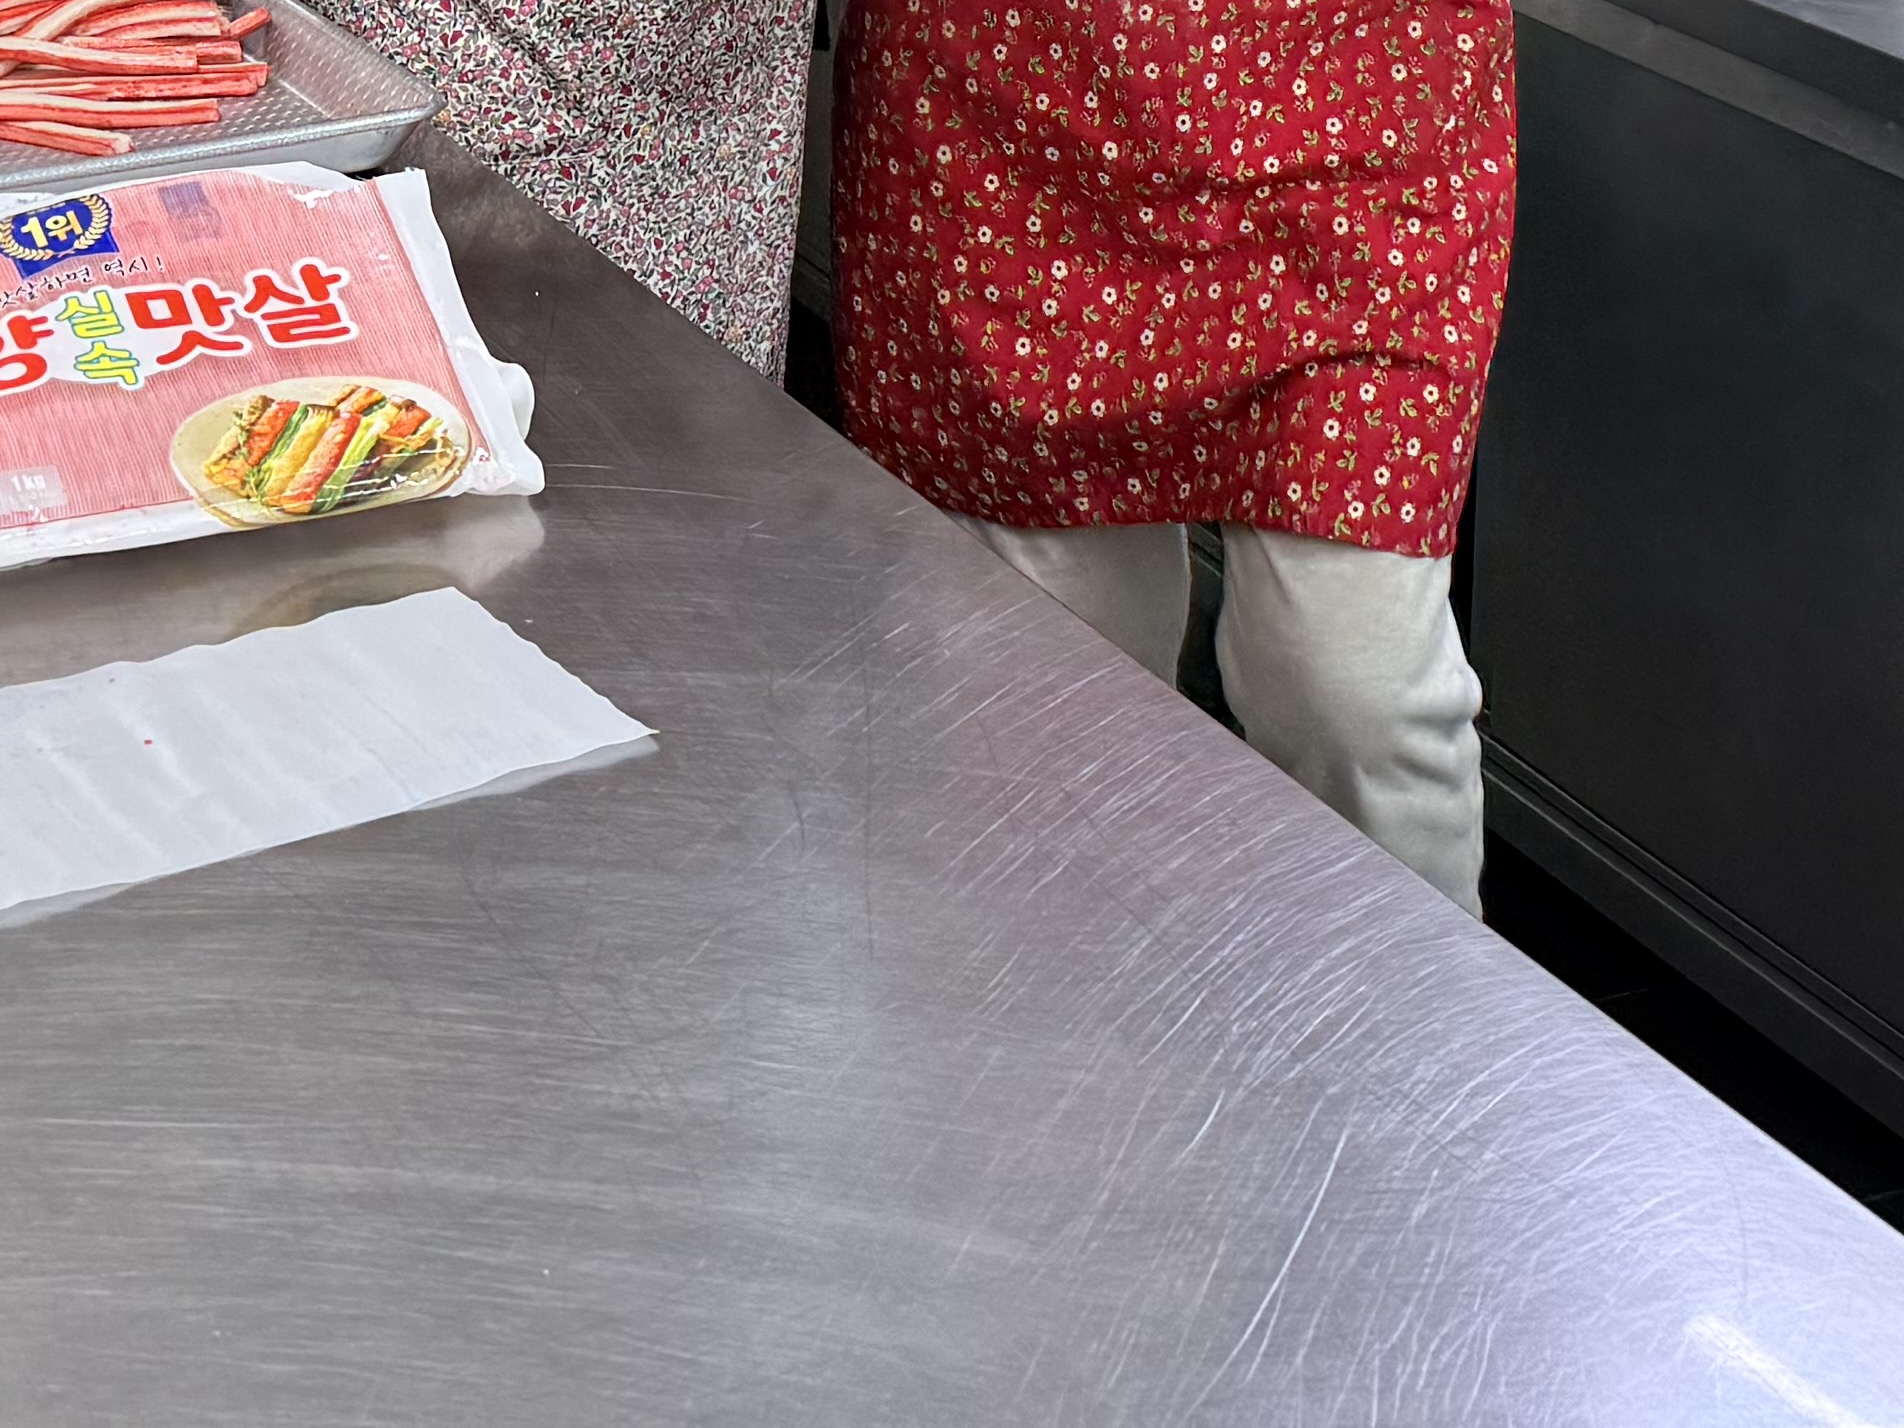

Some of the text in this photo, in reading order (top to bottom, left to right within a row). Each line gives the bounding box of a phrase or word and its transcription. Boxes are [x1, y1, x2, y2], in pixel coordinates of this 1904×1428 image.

[20, 210, 84, 248] 1위
[56, 289, 140, 386] 실속
[125, 262, 352, 366] 맛살
